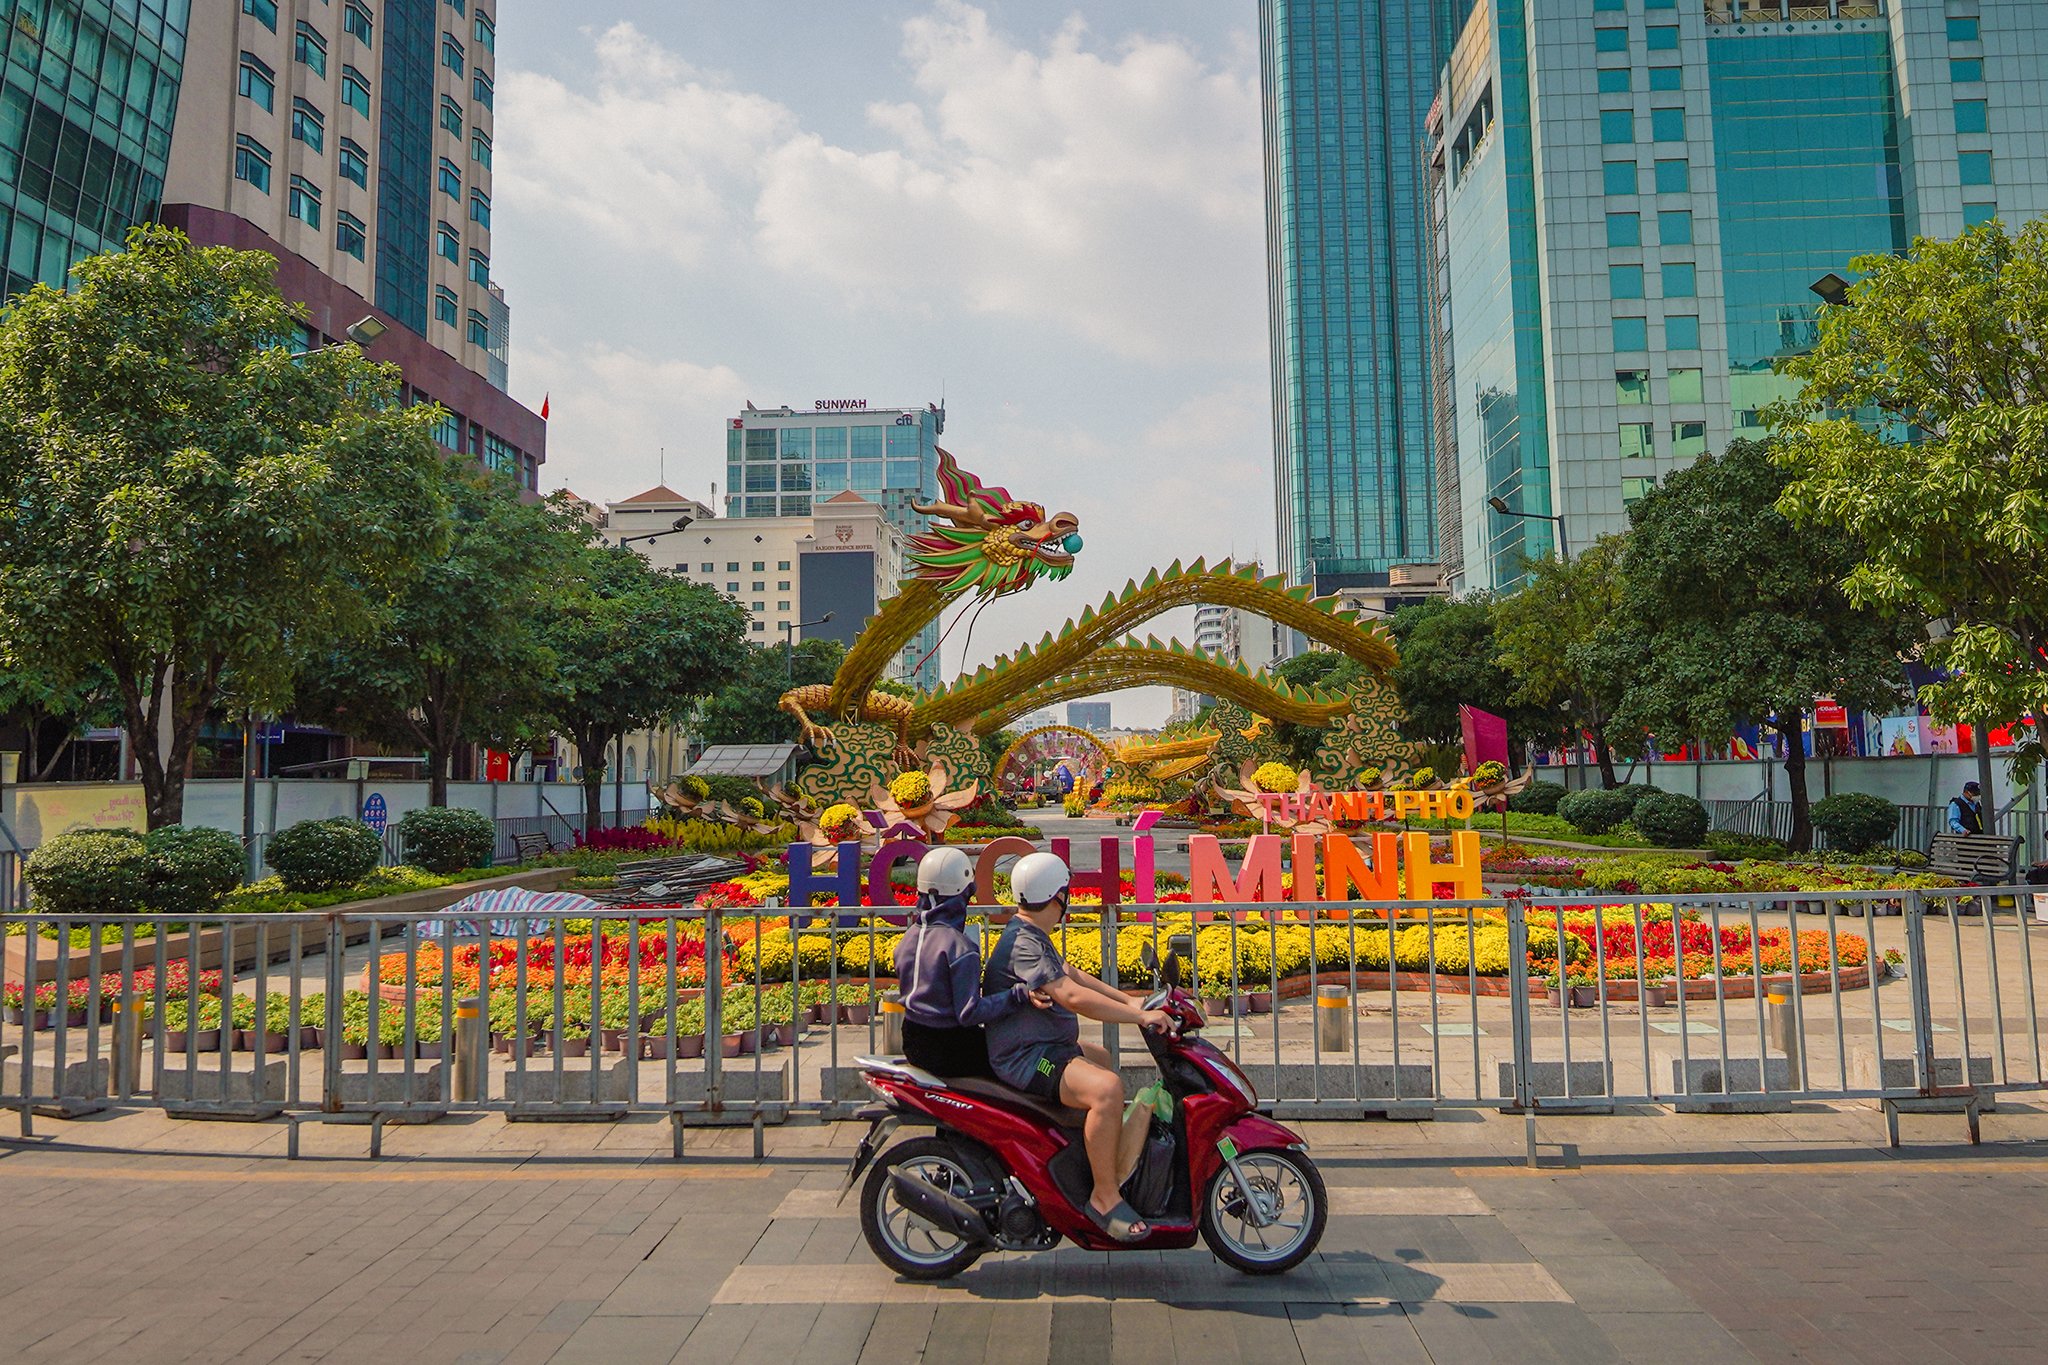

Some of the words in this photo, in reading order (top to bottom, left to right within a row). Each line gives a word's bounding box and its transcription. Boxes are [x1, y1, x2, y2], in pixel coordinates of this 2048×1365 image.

[815, 400, 867, 410] SUNWAH
[896, 414, 913, 426] citi
[1255, 783, 1385, 822] THÀNH
[1393, 776, 1475, 820] PHỐ
[1189, 830, 1484, 921] MINH
